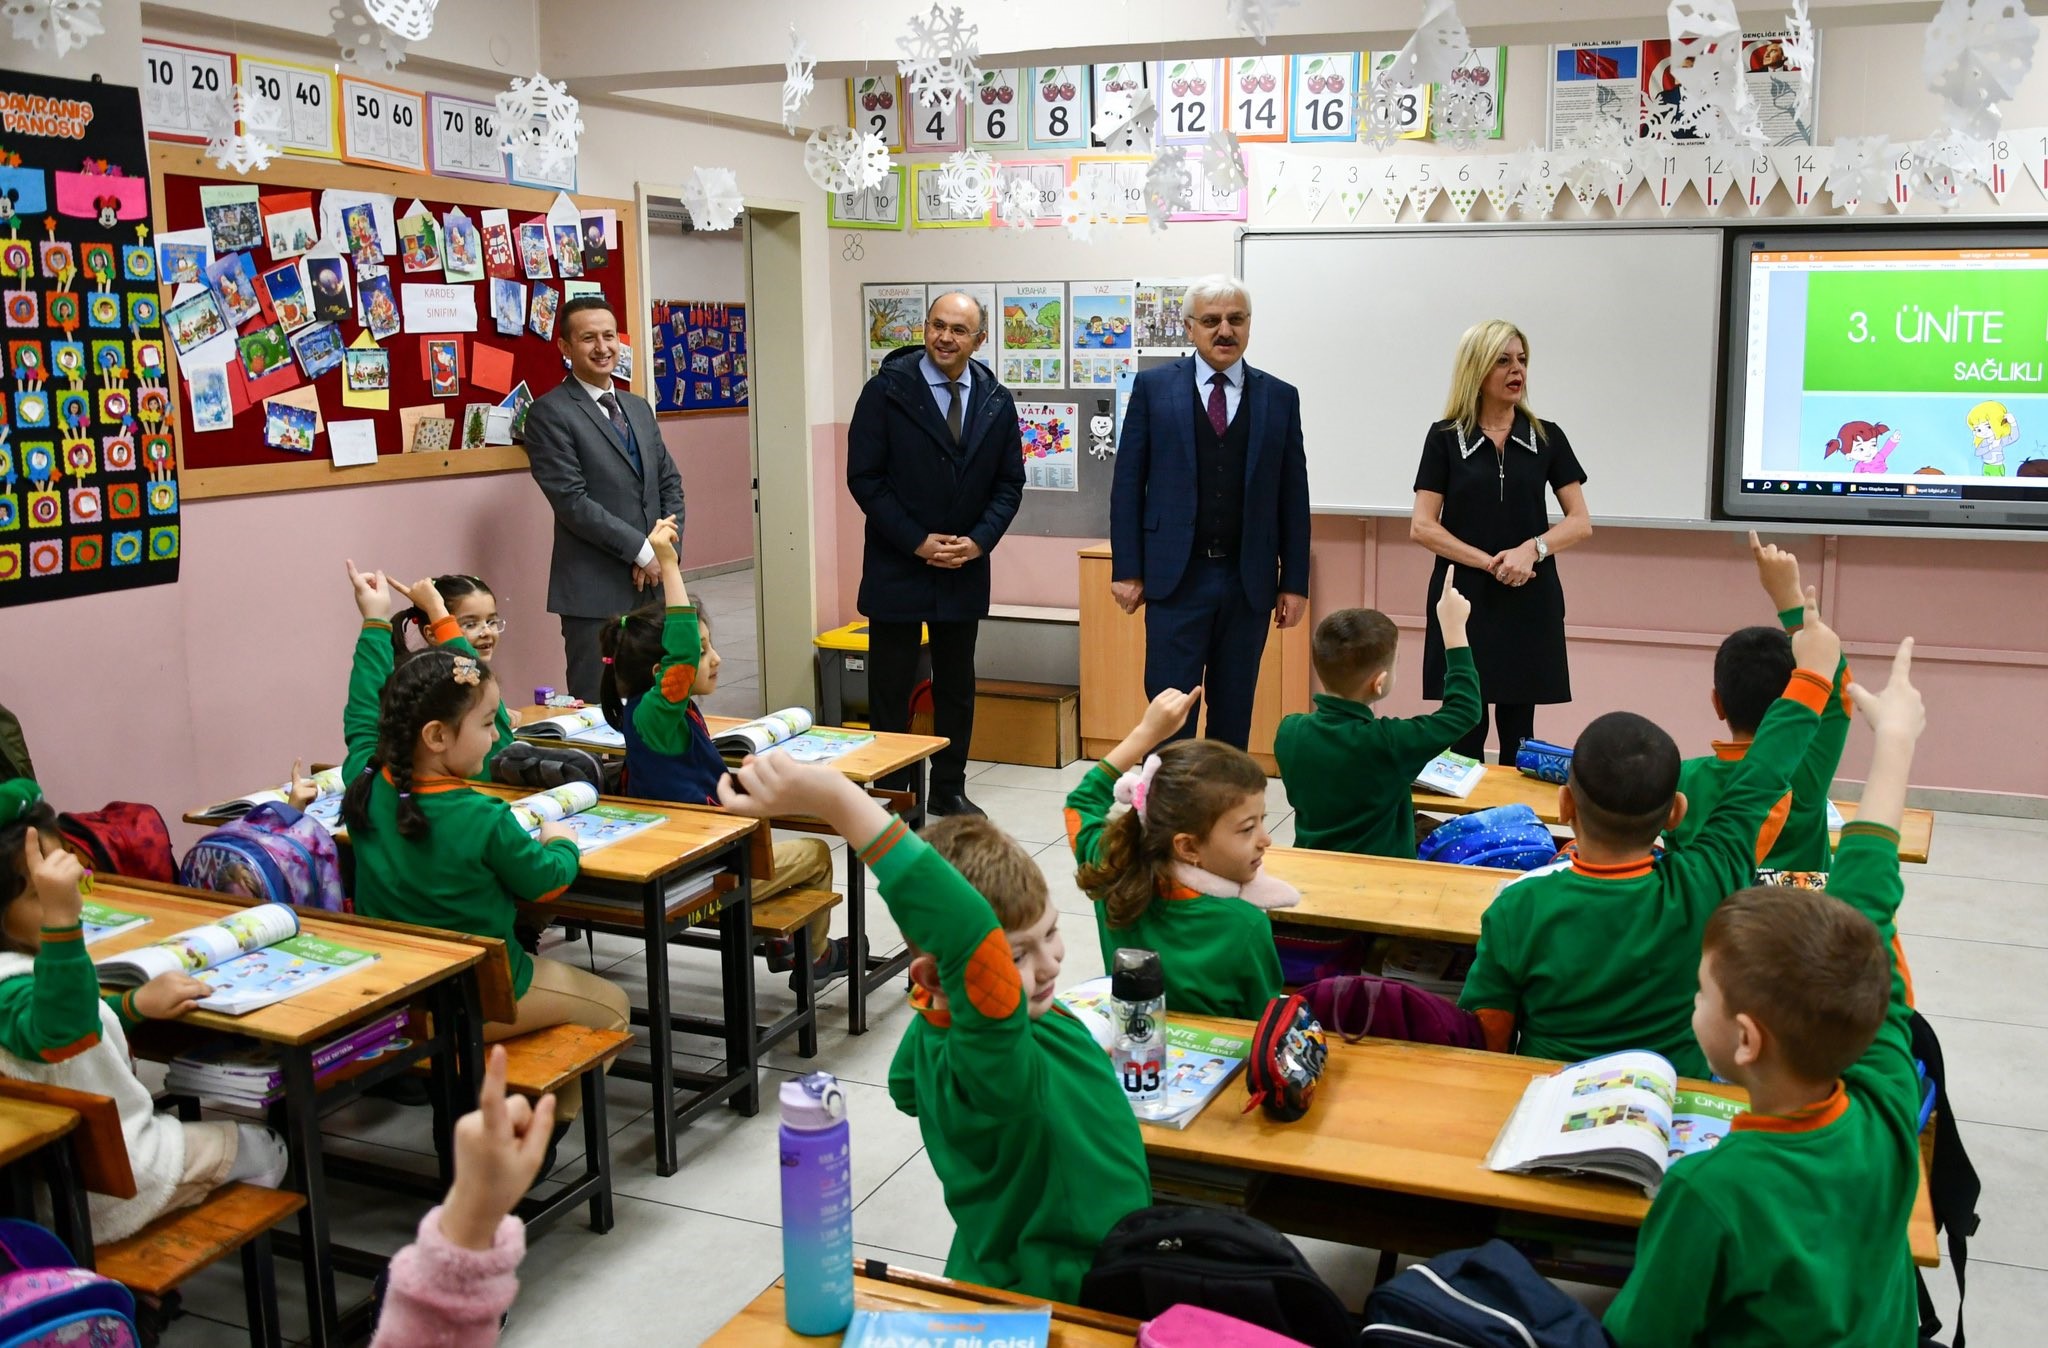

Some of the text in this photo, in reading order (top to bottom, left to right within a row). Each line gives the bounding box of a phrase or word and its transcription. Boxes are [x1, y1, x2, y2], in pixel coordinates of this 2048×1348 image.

[1742, 31, 1776, 39] GENÇLİĞE
[147, 58, 174, 86] 10
[191, 65, 219, 92] 20
[254, 75, 281, 101] 30
[295, 81, 321, 107] 40
[0, 91, 94, 126] DAVRANIŞ
[356, 94, 380, 120] 50
[392, 103, 413, 128] 60
[1238, 98, 1277, 130] 14
[1305, 98, 1343, 131] 16
[443, 110, 464, 133] 70
[474, 115, 493, 138] 80
[925, 111, 945, 141] 4
[987, 108, 1006, 139] 6
[1048, 106, 1069, 136] 8
[1170, 101, 1206, 133] 12
[3, 114, 85, 140] PANOSU
[870, 114, 887, 143] 2
[1987, 141, 2009, 160] 18
[1278, 160, 1285, 177] 1
[1384, 164, 1398, 181] 4
[1419, 163, 1430, 182] 5
[1458, 164, 1470, 182] 6
[1663, 156, 1676, 175] 11
[1751, 154, 1769, 174] 13
[1793, 154, 1816, 173] 14
[1311, 165, 1322, 183] 2
[1347, 166, 1358, 184] 3
[846, 194, 854, 206] 5
[875, 195, 889, 208] 10
[926, 194, 941, 206] 15
[1039, 190, 1057, 203] 30
[1124, 188, 1141, 201] 40
[424, 287, 456, 301] KARDEŞ
[878, 288, 911, 297] SONBAHAR
[1016, 286, 1048, 296] İLKBAHAR
[1094, 285, 1110, 294] YAZ
[426, 308, 457, 319] SINIFIM
[1847, 303, 2005, 344] 3. ÜNİTE
[1953, 358, 2043, 382] SAĞLIKLI
[1020, 407, 1055, 416] VATAN
[1166, 1027, 1198, 1041] NİTE
[1123, 1060, 1160, 1093] 03
[1694, 1095, 1744, 1114] ÜNİTE
